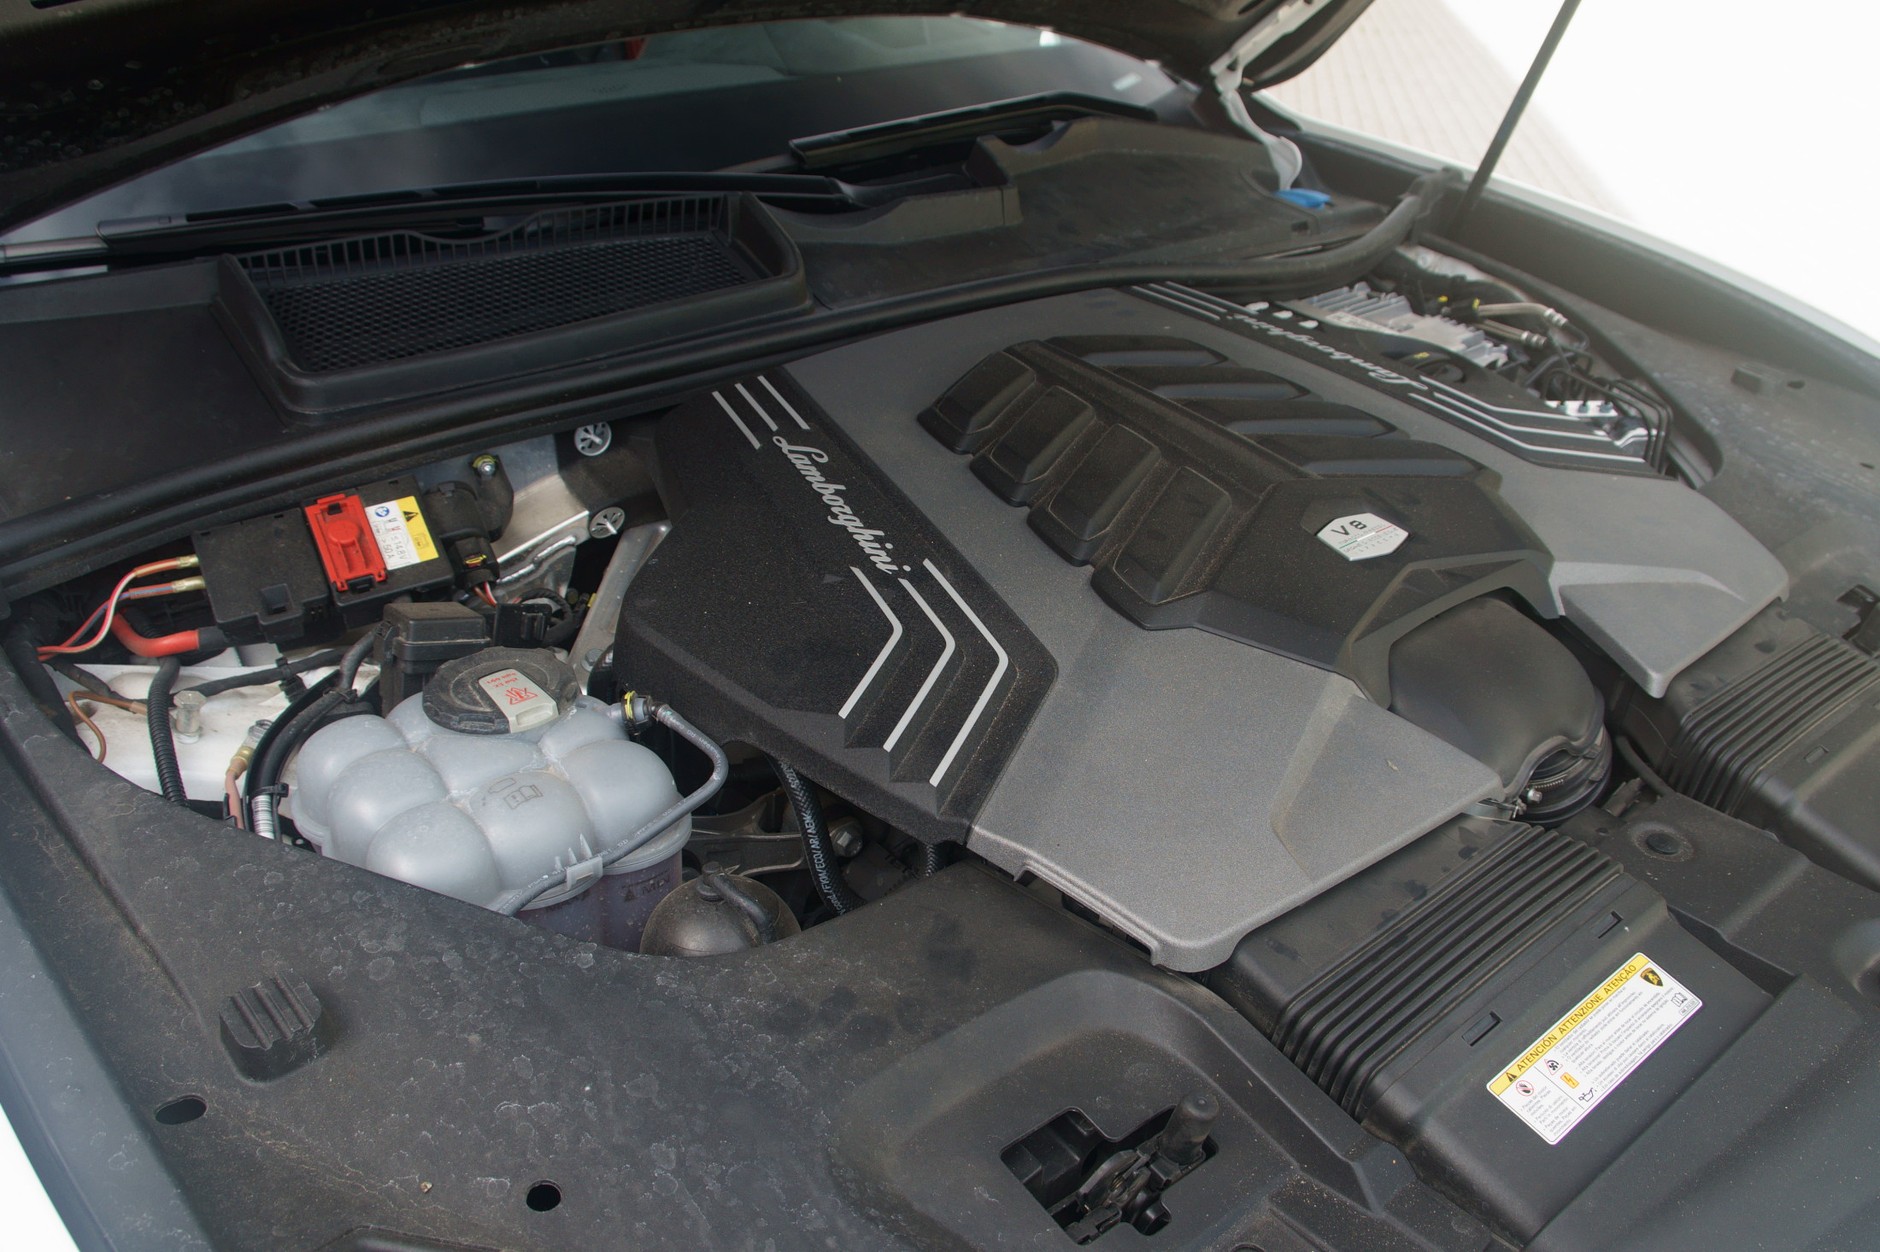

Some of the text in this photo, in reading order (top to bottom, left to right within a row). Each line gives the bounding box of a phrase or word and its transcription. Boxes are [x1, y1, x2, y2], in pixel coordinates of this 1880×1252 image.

[1226, 313, 1428, 390] Lamborghini
[772, 436, 912, 574] Lamborghini
[1331, 520, 1367, 536] V8
[1516, 1033, 1558, 1072] ATENCIÓN
[1558, 993, 1604, 1034] ATTENZIONE
[1603, 964, 1637, 994] ATENÇÃO
